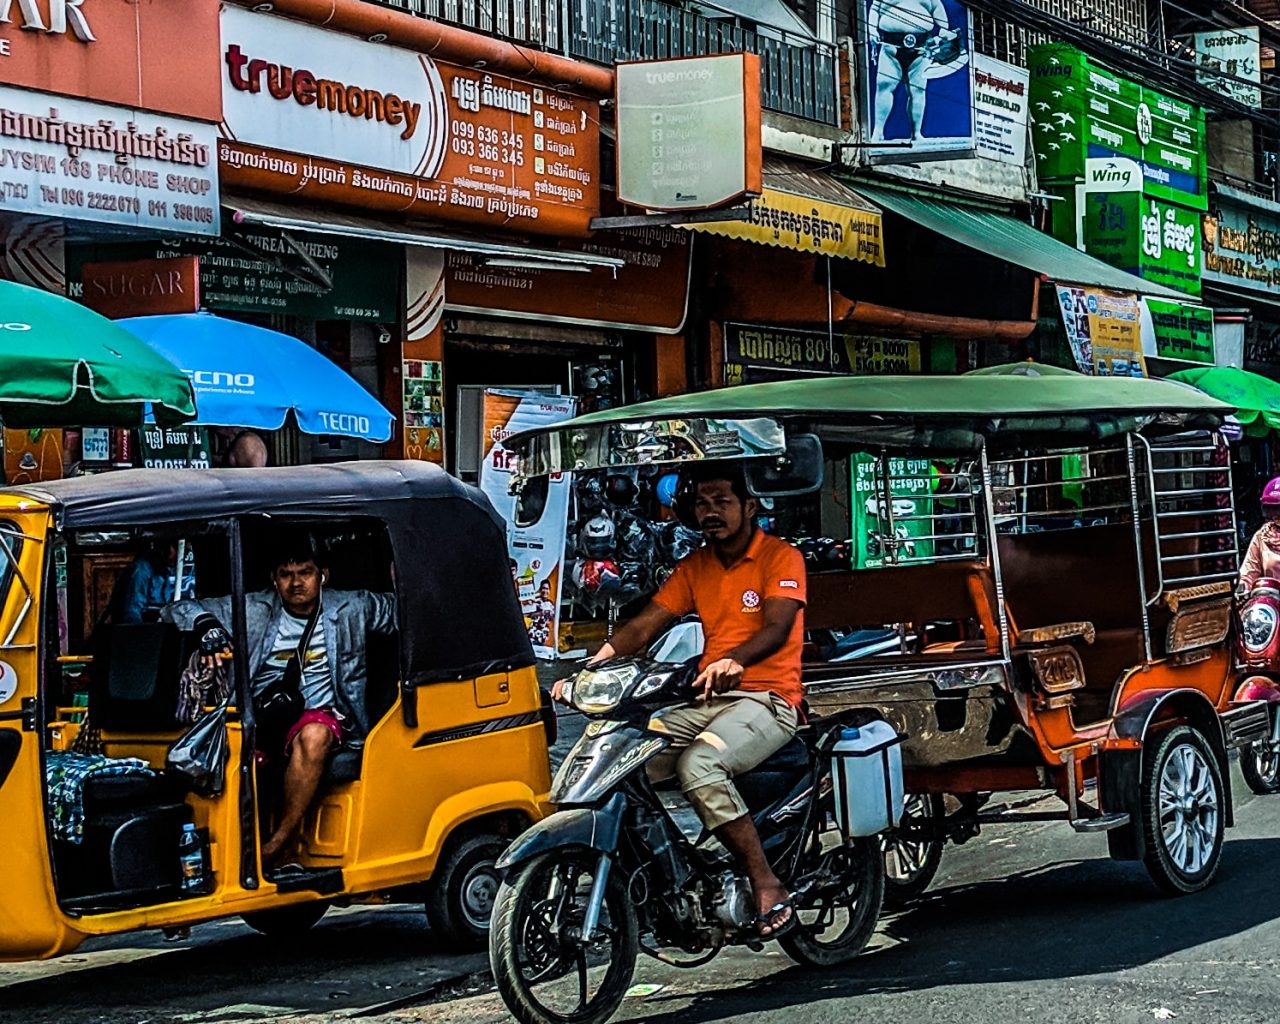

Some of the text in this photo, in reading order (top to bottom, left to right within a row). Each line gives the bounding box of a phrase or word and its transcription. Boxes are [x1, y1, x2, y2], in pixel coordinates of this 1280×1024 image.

[646, 70, 713, 84] truemoney
[225, 44, 421, 140] truemoney
[452, 120, 523, 149] 099 636 345
[452, 137, 524, 166] 093 366 345
[60, 158, 91, 179] 168
[98, 164, 158, 189] PHONE
[166, 174, 211, 196] SHOP
[1092, 170, 1131, 187] Wing
[40, 185, 58, 202] Tel
[62, 190, 84, 206] 096
[92, 270, 185, 299] SUGAR
[805, 338, 840, 364] 80%
[318, 411, 370, 434] TECNO
